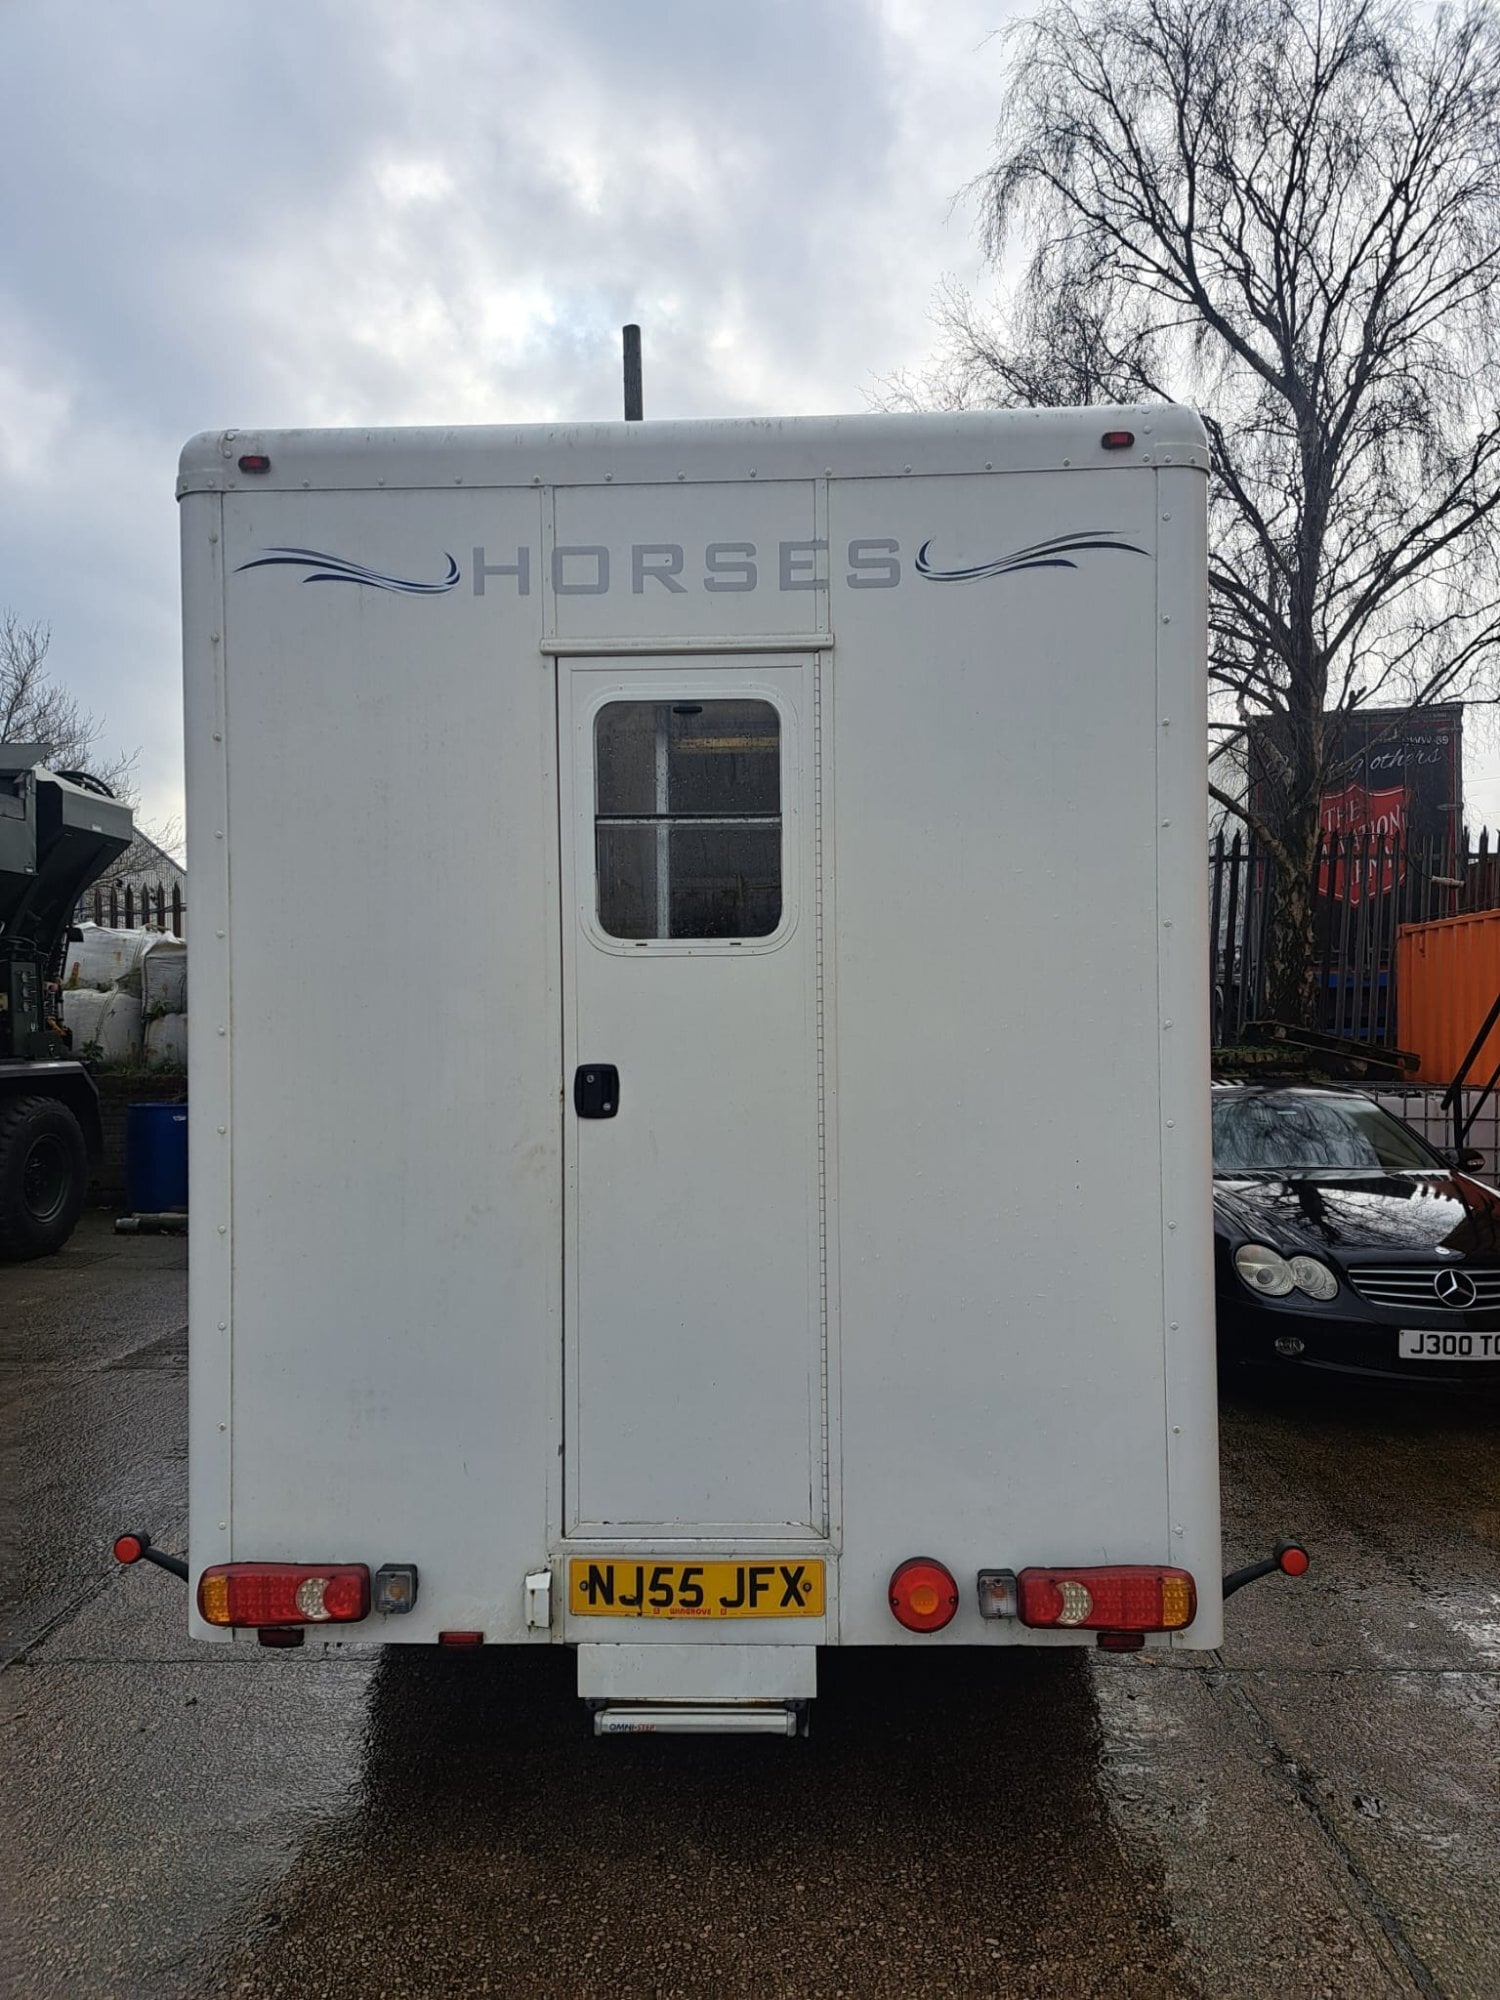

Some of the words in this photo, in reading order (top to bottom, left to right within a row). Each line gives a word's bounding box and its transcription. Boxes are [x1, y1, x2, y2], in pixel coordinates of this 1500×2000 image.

[472, 538, 901, 597] HORSES
[1370, 748, 1441, 771] others
[1410, 1333, 1473, 1356] J300
[588, 1564, 704, 1608] NJ55
[719, 1566, 805, 1608] JFX
